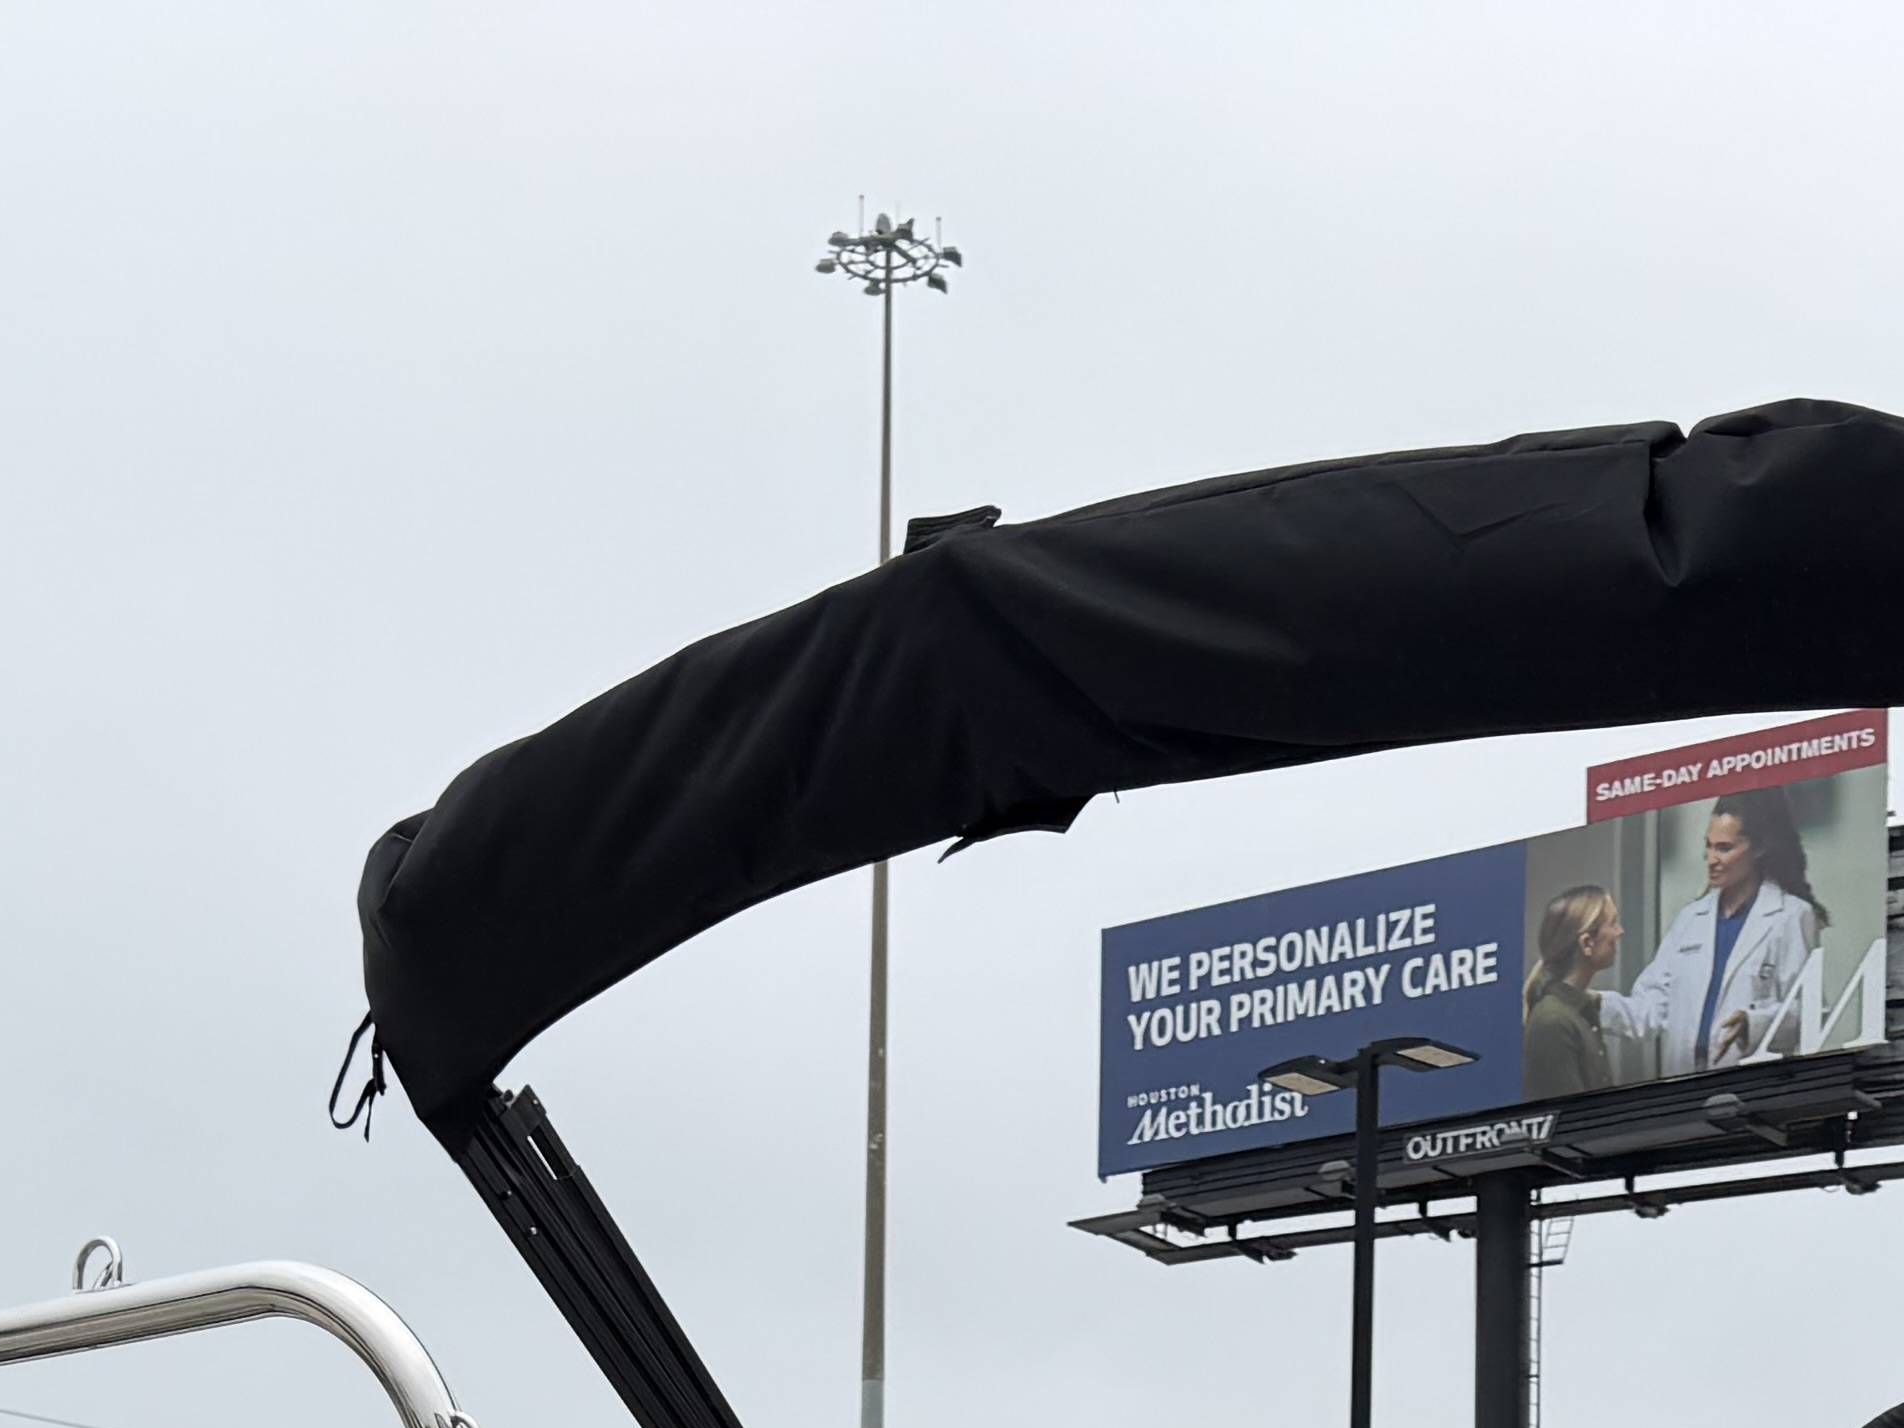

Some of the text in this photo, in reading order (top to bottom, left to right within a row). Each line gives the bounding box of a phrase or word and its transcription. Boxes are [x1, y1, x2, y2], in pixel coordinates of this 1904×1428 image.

[1595, 728, 1876, 801] SAME-DAY APPOINTMENTS
[1128, 903, 1437, 1003] WE PERSONALIZE
[1127, 942, 1498, 1051] YOUR PRIMARY CARE
[1126, 1082, 1309, 1145] Methodist
[1127, 1083, 1201, 1108] HOUSTON
